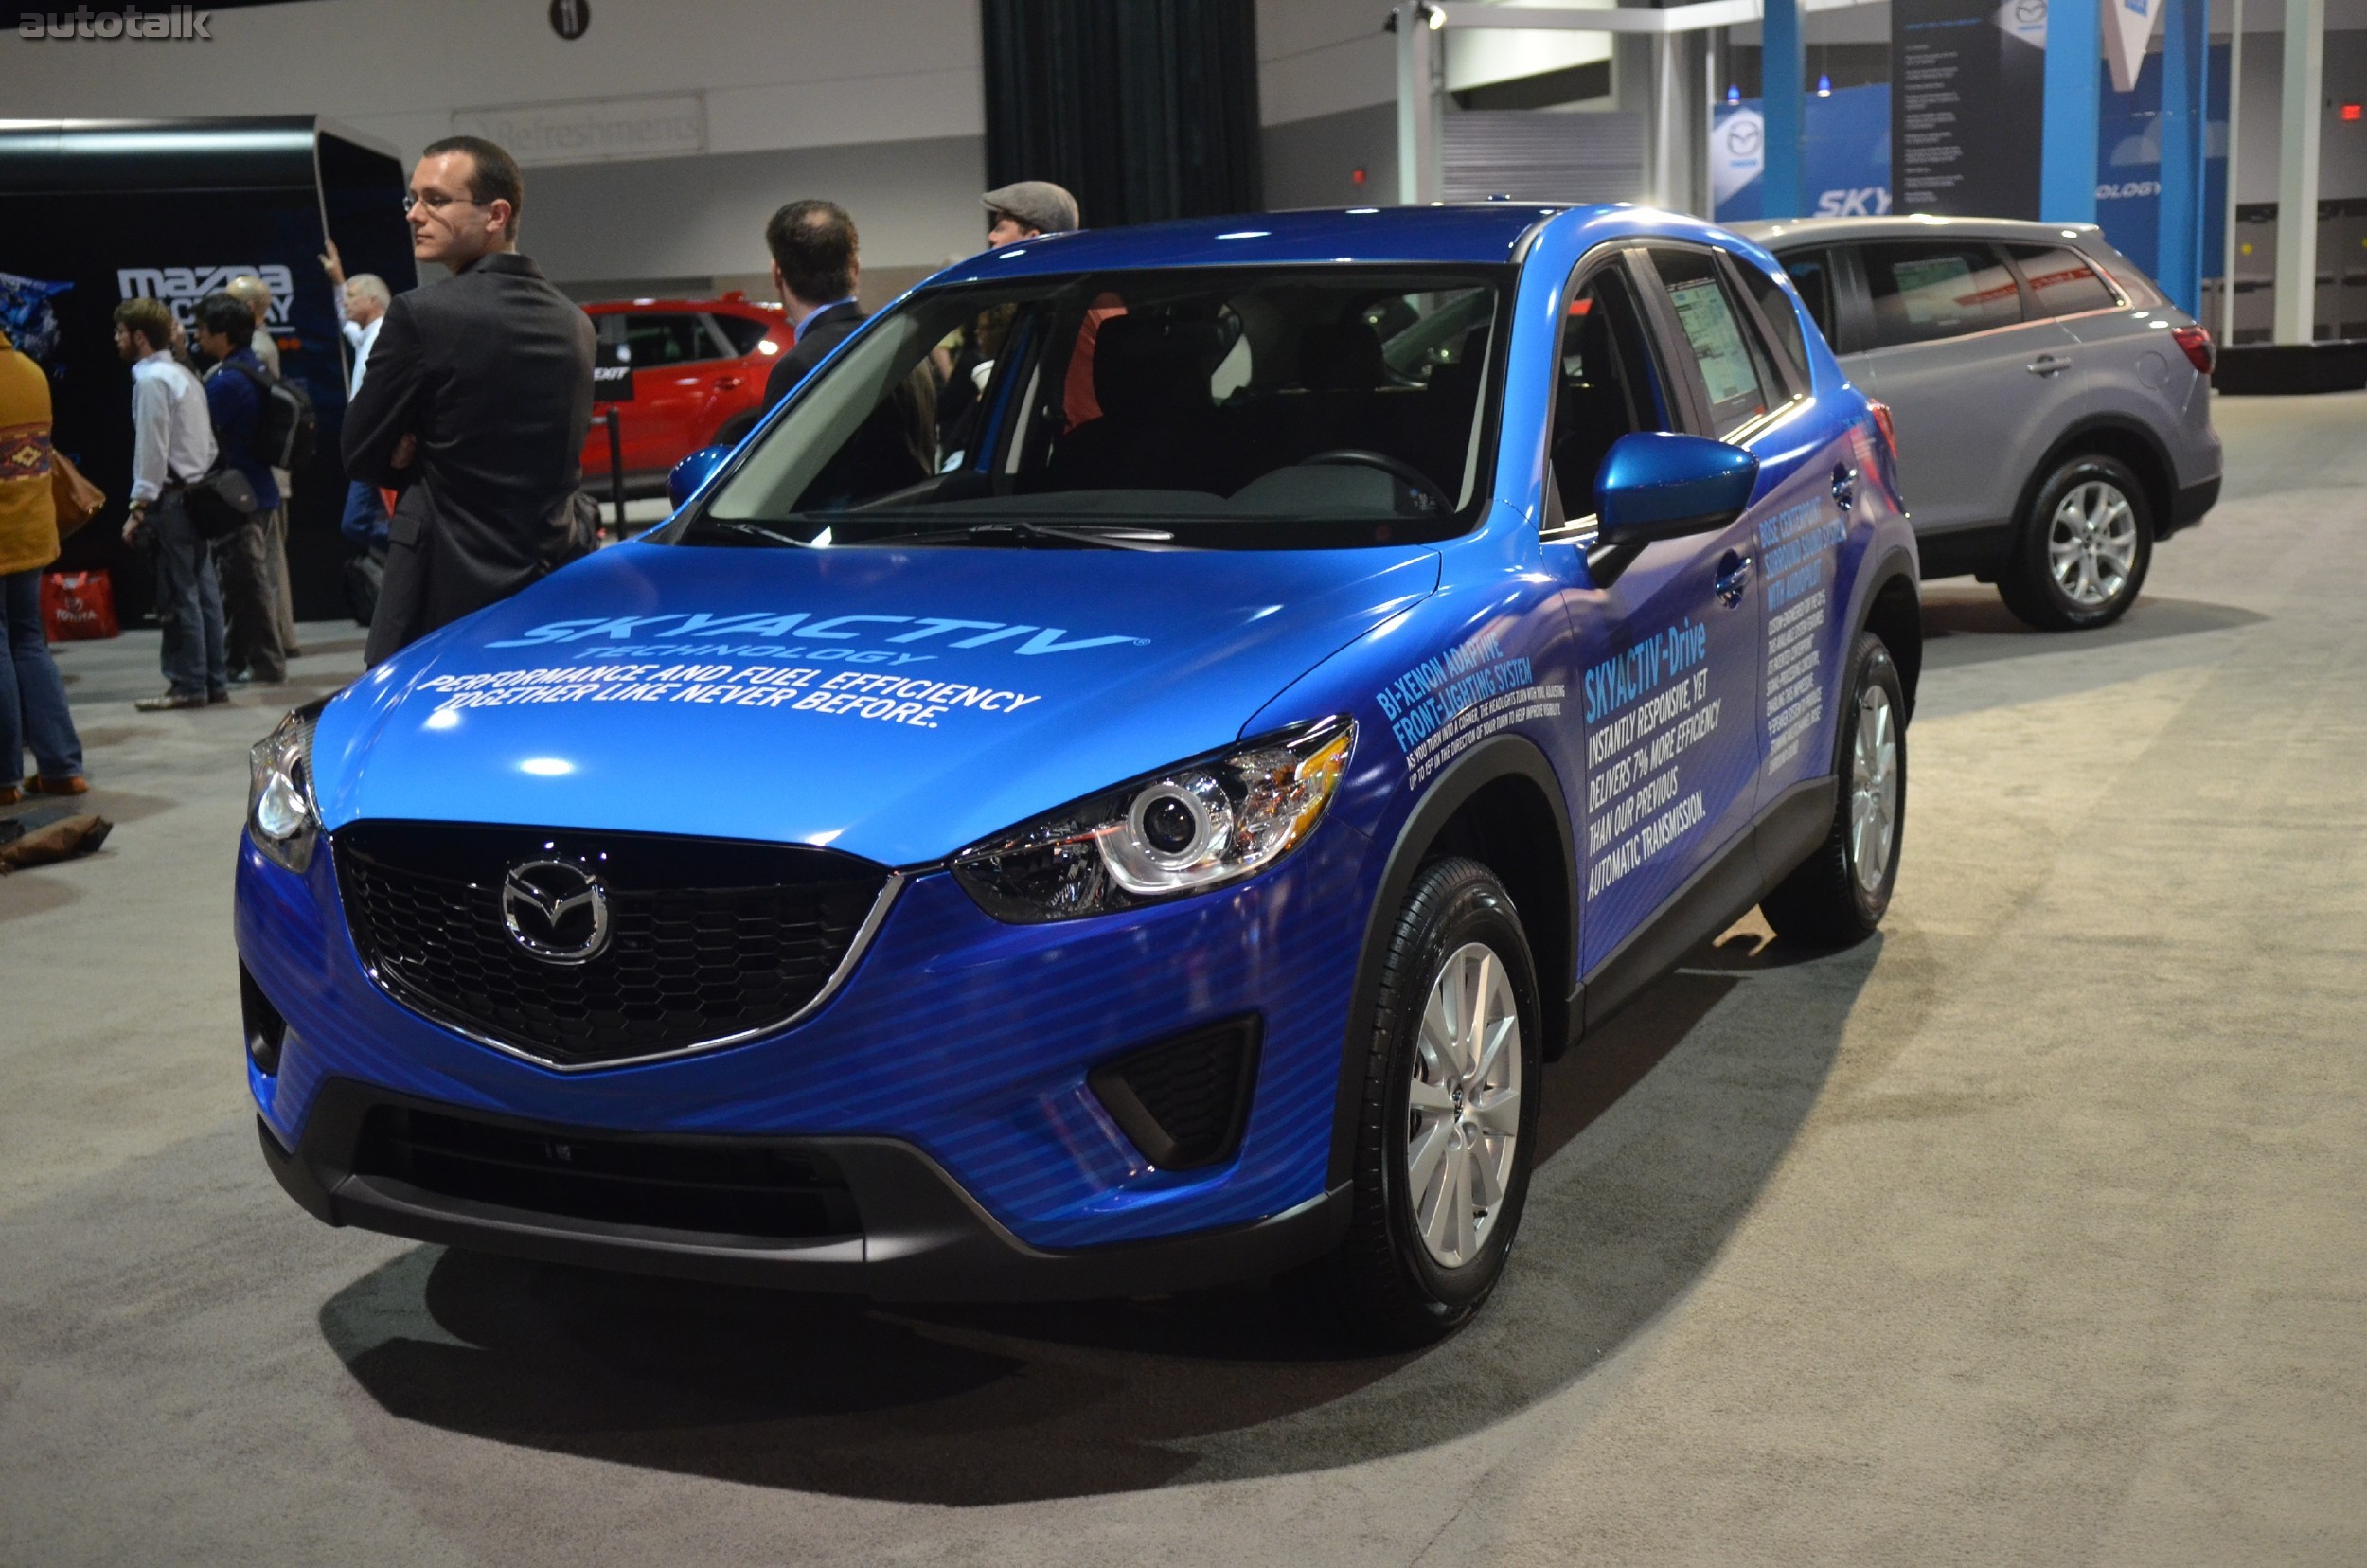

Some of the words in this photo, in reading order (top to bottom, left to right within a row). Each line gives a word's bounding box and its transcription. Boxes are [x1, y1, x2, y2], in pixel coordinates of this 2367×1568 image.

[417, 664, 660, 692] PERFORMANCE
[646, 665, 734, 684] AND
[728, 666, 822, 687] FUEL
[819, 670, 1042, 713] EFFICIENCY
[572, 644, 939, 666] TECHNOLOGY
[1376, 656, 1448, 722] BI-XENON
[1442, 632, 1504, 678] ADAPTIVE
[433, 683, 601, 712] TOGETHER
[591, 683, 682, 702] LIKE
[669, 684, 799, 707] NEVER
[792, 687, 950, 729] BEFORE.
[1392, 668, 1496, 753] FRONT-LIGHTING
[1494, 657, 1533, 692] SYSTEM
[1406, 753, 1416, 772] AS
[1414, 742, 1428, 763] YOU
[1426, 730, 1442, 753] TURN
[1442, 722, 1454, 742] INTO
[1454, 720, 1459, 735] A
[1459, 707, 1480, 731] CORNER,
[1479, 702, 1489, 719] THE
[1488, 691, 1516, 714] HEADLIGHTS
[1516, 688, 1527, 704] TURN
[1409, 772, 1417, 791] UP
[1417, 765, 1425, 783] TO
[1433, 752, 1441, 769] IN
[1441, 744, 1451, 763] THE
[1450, 728, 1476, 757] DIRECTION
[1476, 724, 1484, 740] OF
[1483, 718, 1496, 737] YOUR
[1496, 712, 1508, 730] TURN
[1508, 710, 1515, 727] TO
[1515, 706, 1526, 723] HELP
[1588, 710, 1637, 770] INSTANTLY
[1636, 677, 1691, 740] RESPONSIVE,
[1692, 667, 1709, 703] YET
[1588, 756, 1631, 814] DELIVERS
[1632, 744, 1649, 784] 7%
[1649, 726, 1677, 773] MORE
[1675, 697, 1722, 754] EFFICIENCY
[1586, 837, 1642, 903] AUTOMATIC
[1640, 789, 1707, 861] TRANSMISSION.
[1589, 811, 1612, 858] THAN
[1613, 795, 1635, 838] OUR
[1635, 764, 1679, 823] PREVIOUS
